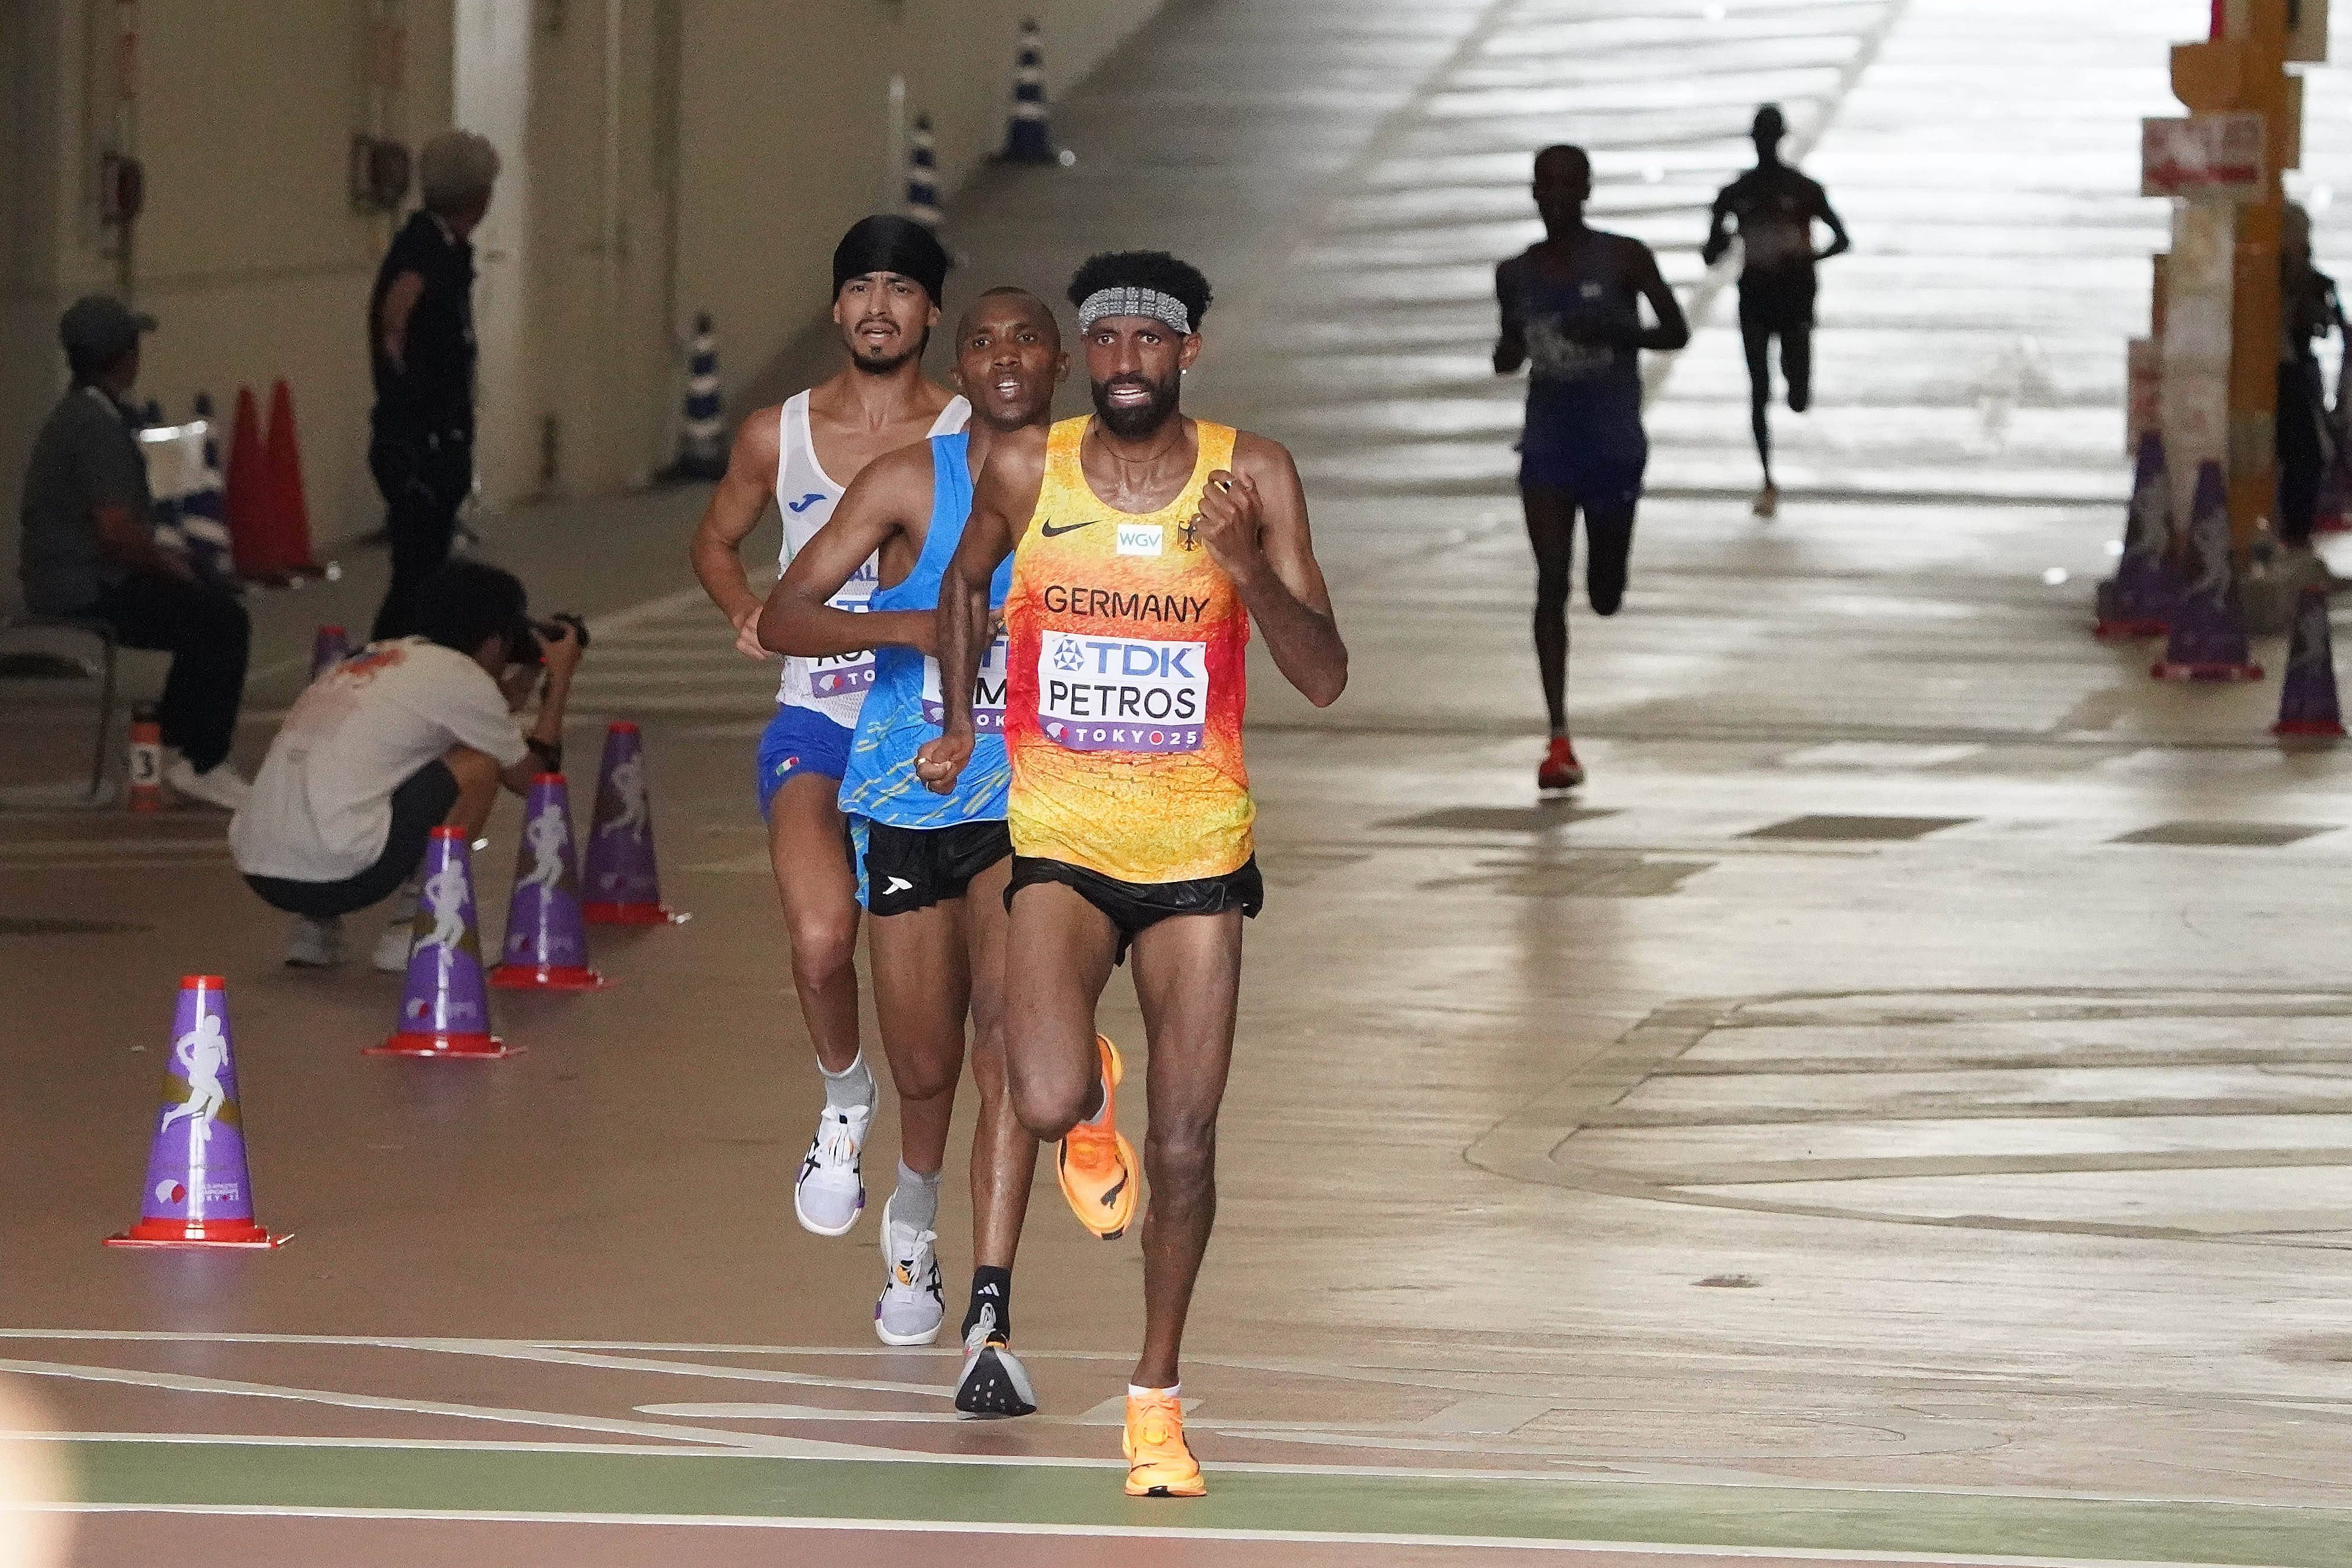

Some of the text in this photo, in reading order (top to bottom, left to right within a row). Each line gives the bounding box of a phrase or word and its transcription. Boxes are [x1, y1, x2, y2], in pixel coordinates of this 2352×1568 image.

[1119, 533, 1160, 546] WGV
[1044, 585, 1210, 623] GERMANY
[1086, 641, 1195, 678] TDK
[1050, 680, 1196, 719] PETROS
